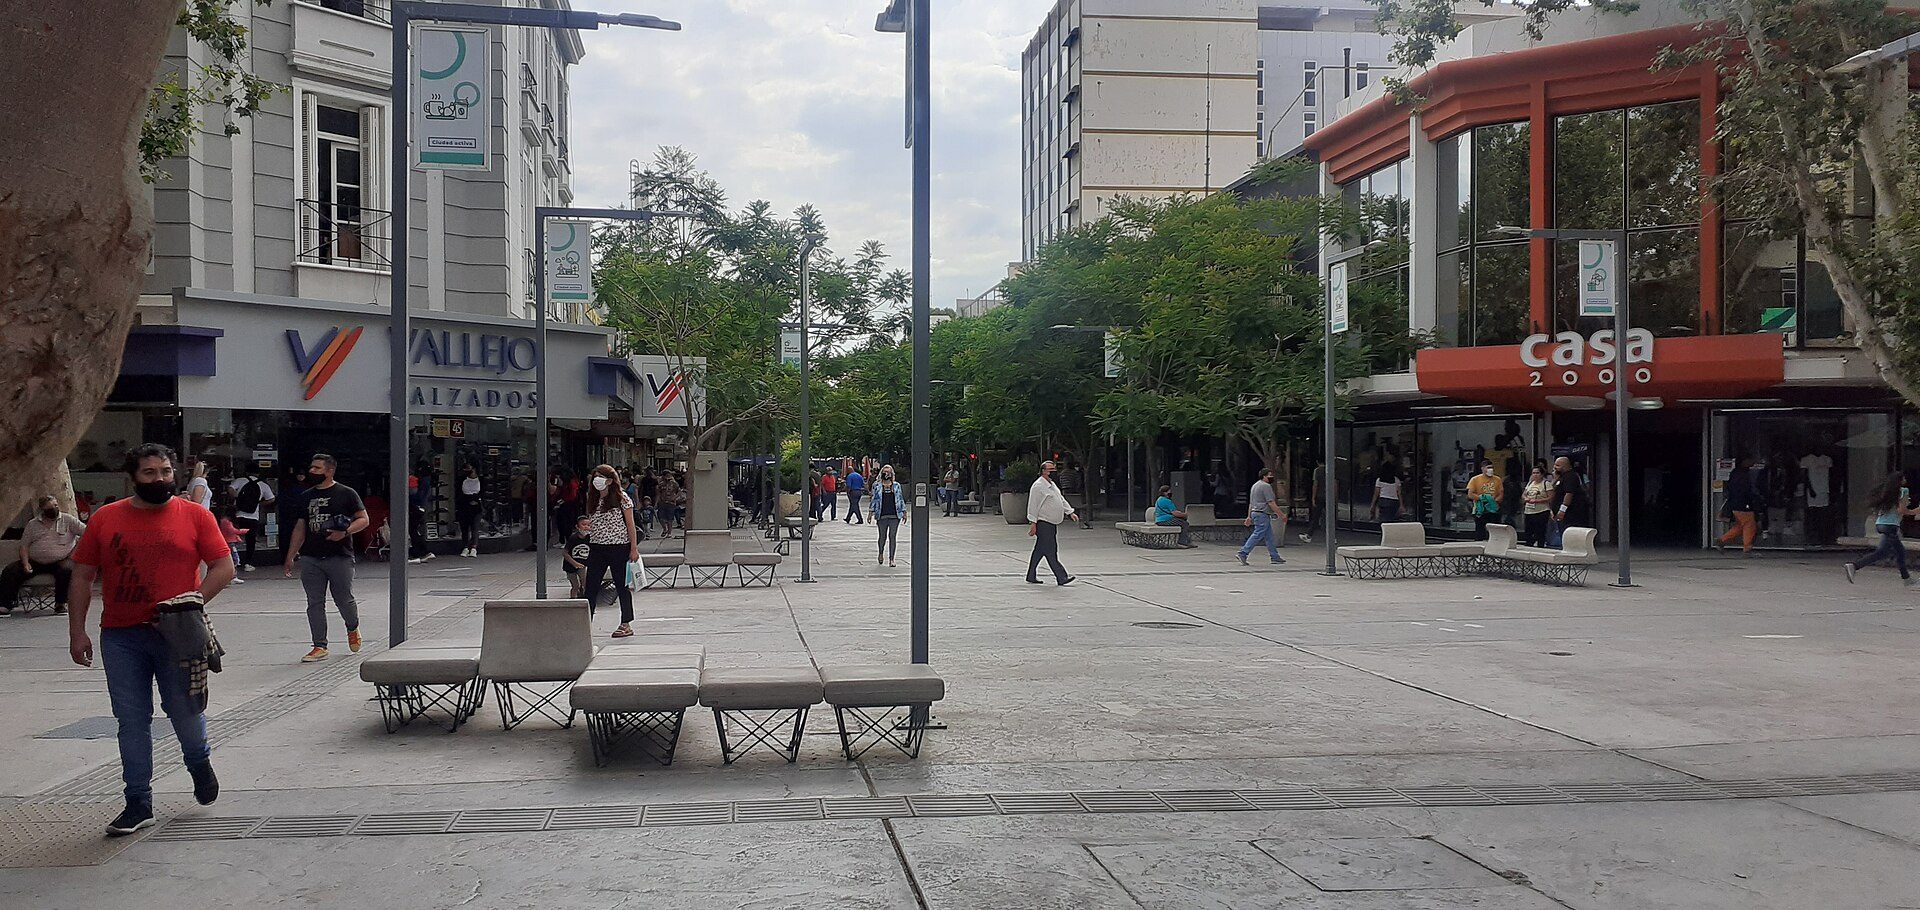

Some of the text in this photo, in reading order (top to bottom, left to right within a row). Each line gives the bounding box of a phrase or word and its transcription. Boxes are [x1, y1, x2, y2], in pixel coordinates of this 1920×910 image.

[1519, 327, 1655, 368] casa
[1529, 368, 1652, 387] 2000
[409, 386, 538, 409] ALZADOS
[452, 421, 463, 434] 45
